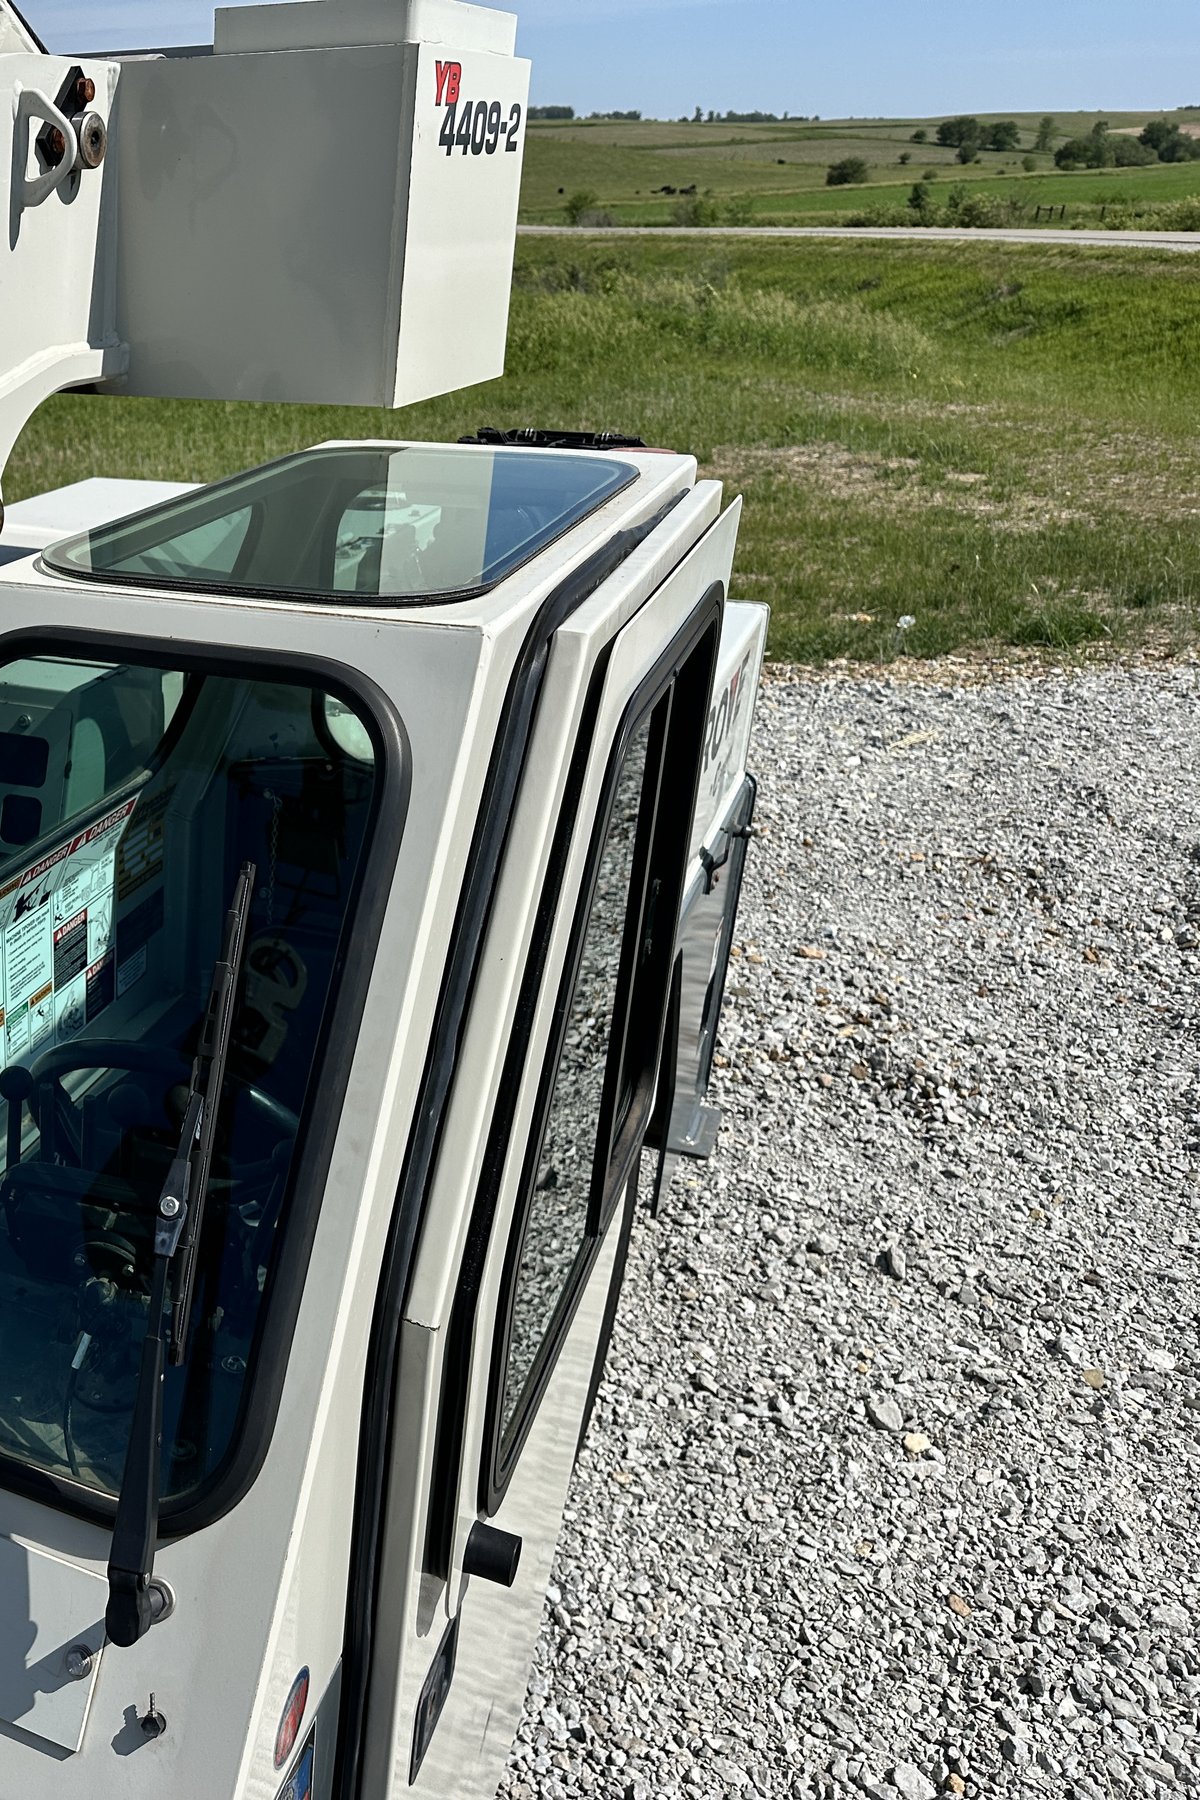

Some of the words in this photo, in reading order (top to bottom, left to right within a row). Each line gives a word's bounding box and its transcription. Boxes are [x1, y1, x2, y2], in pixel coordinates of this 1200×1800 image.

[435, 60, 461, 106] YB
[438, 101, 521, 156] 4409-2
[89, 805, 129, 840] DANGER
[32, 847, 68, 877] DANGER
[62, 912, 85, 933] DANGER
